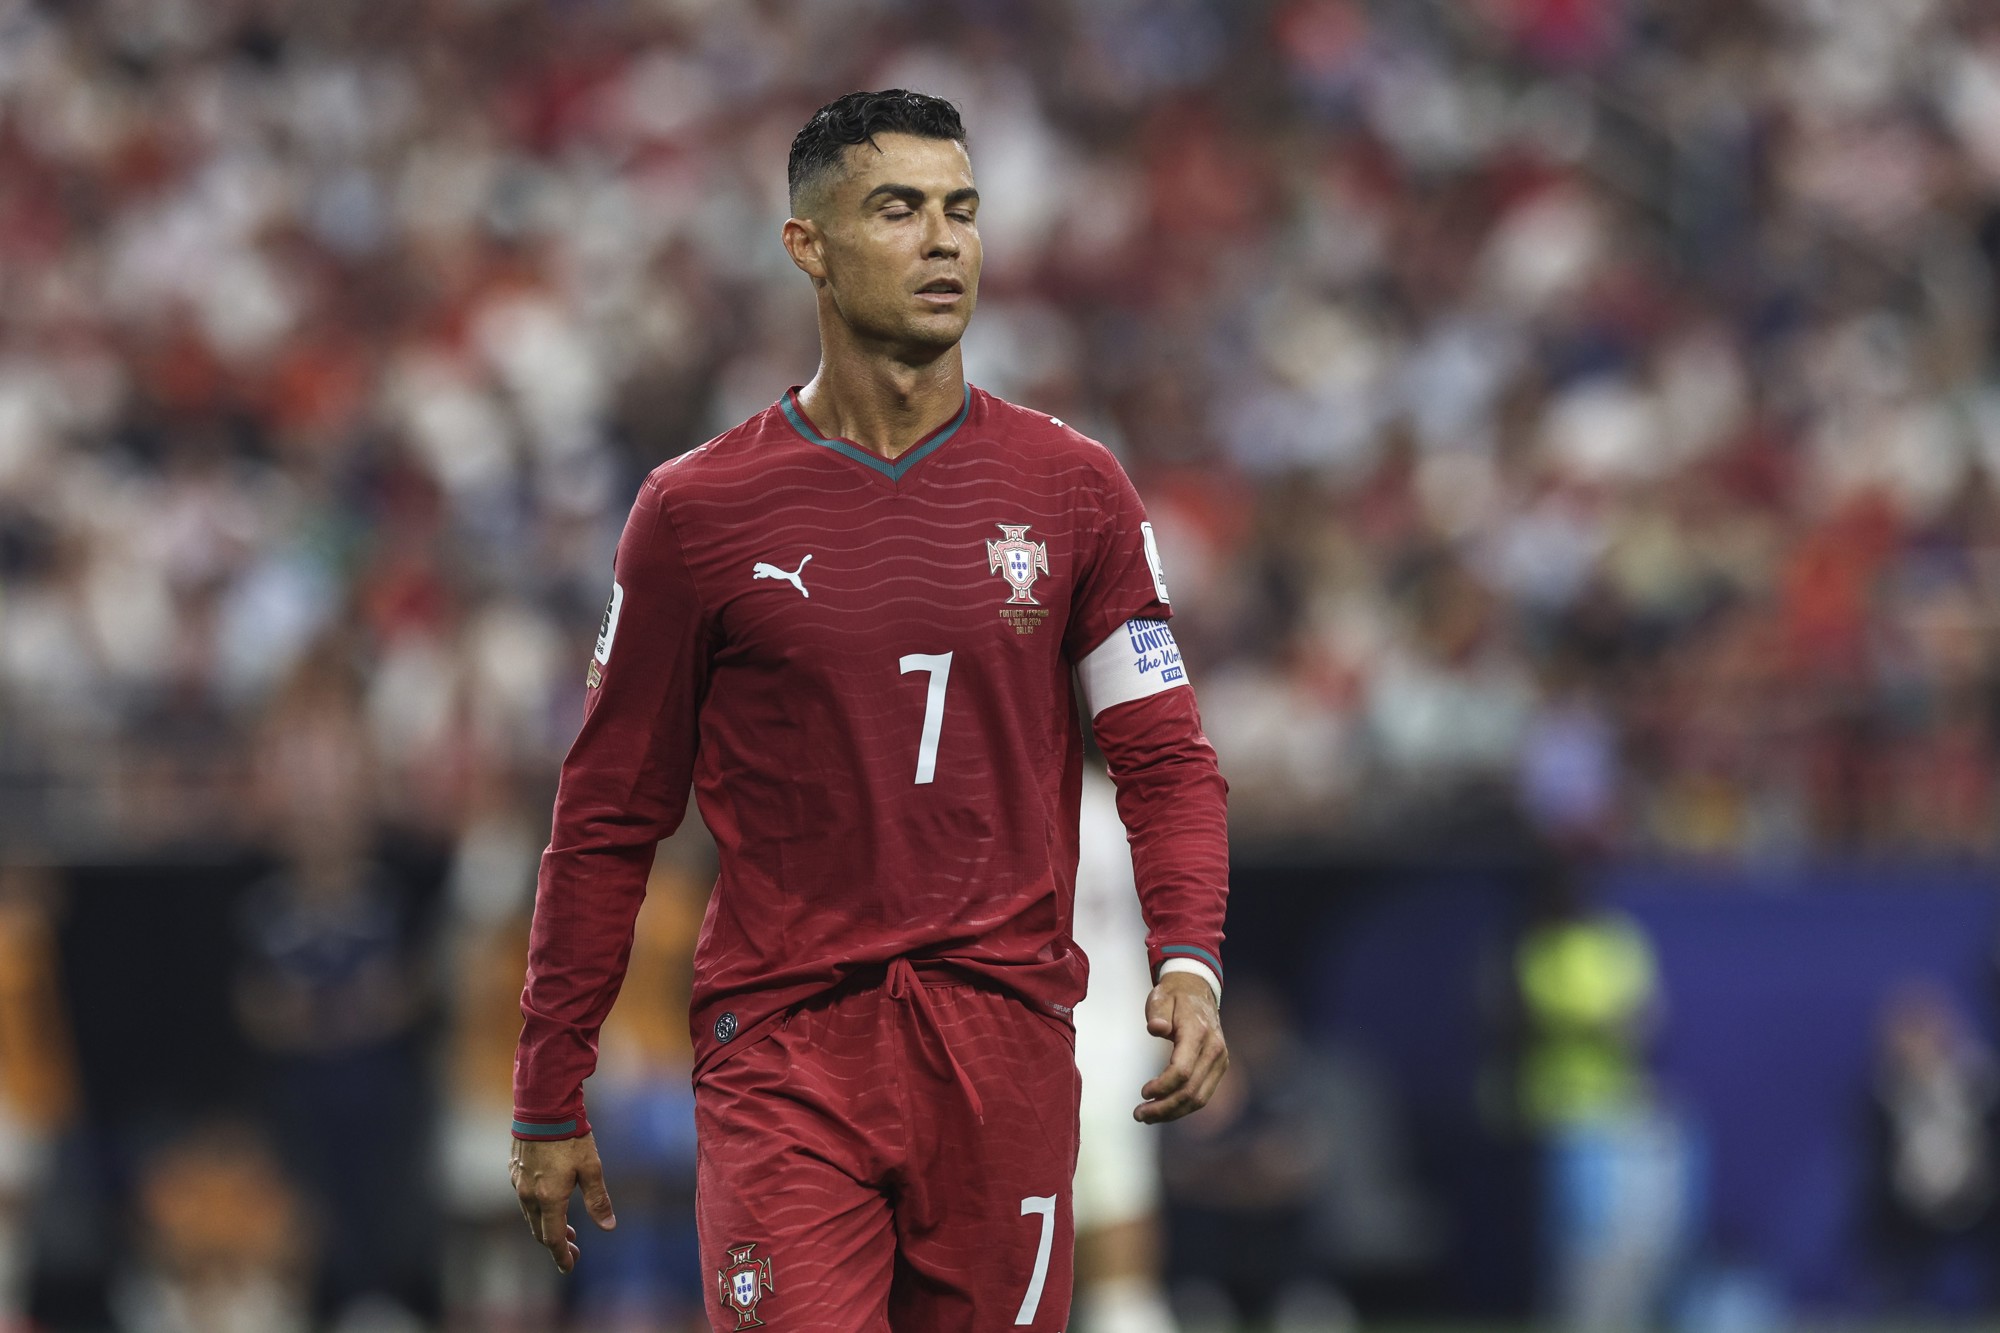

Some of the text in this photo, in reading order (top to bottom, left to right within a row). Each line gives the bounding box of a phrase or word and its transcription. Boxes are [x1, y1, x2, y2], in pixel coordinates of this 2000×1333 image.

[1131, 626, 1174, 654] UNITE
[1134, 654, 1161, 674] the
[1164, 668, 1182, 681] FIFA
[899, 650, 953, 785] 7
[1014, 1193, 1057, 1326] 7
